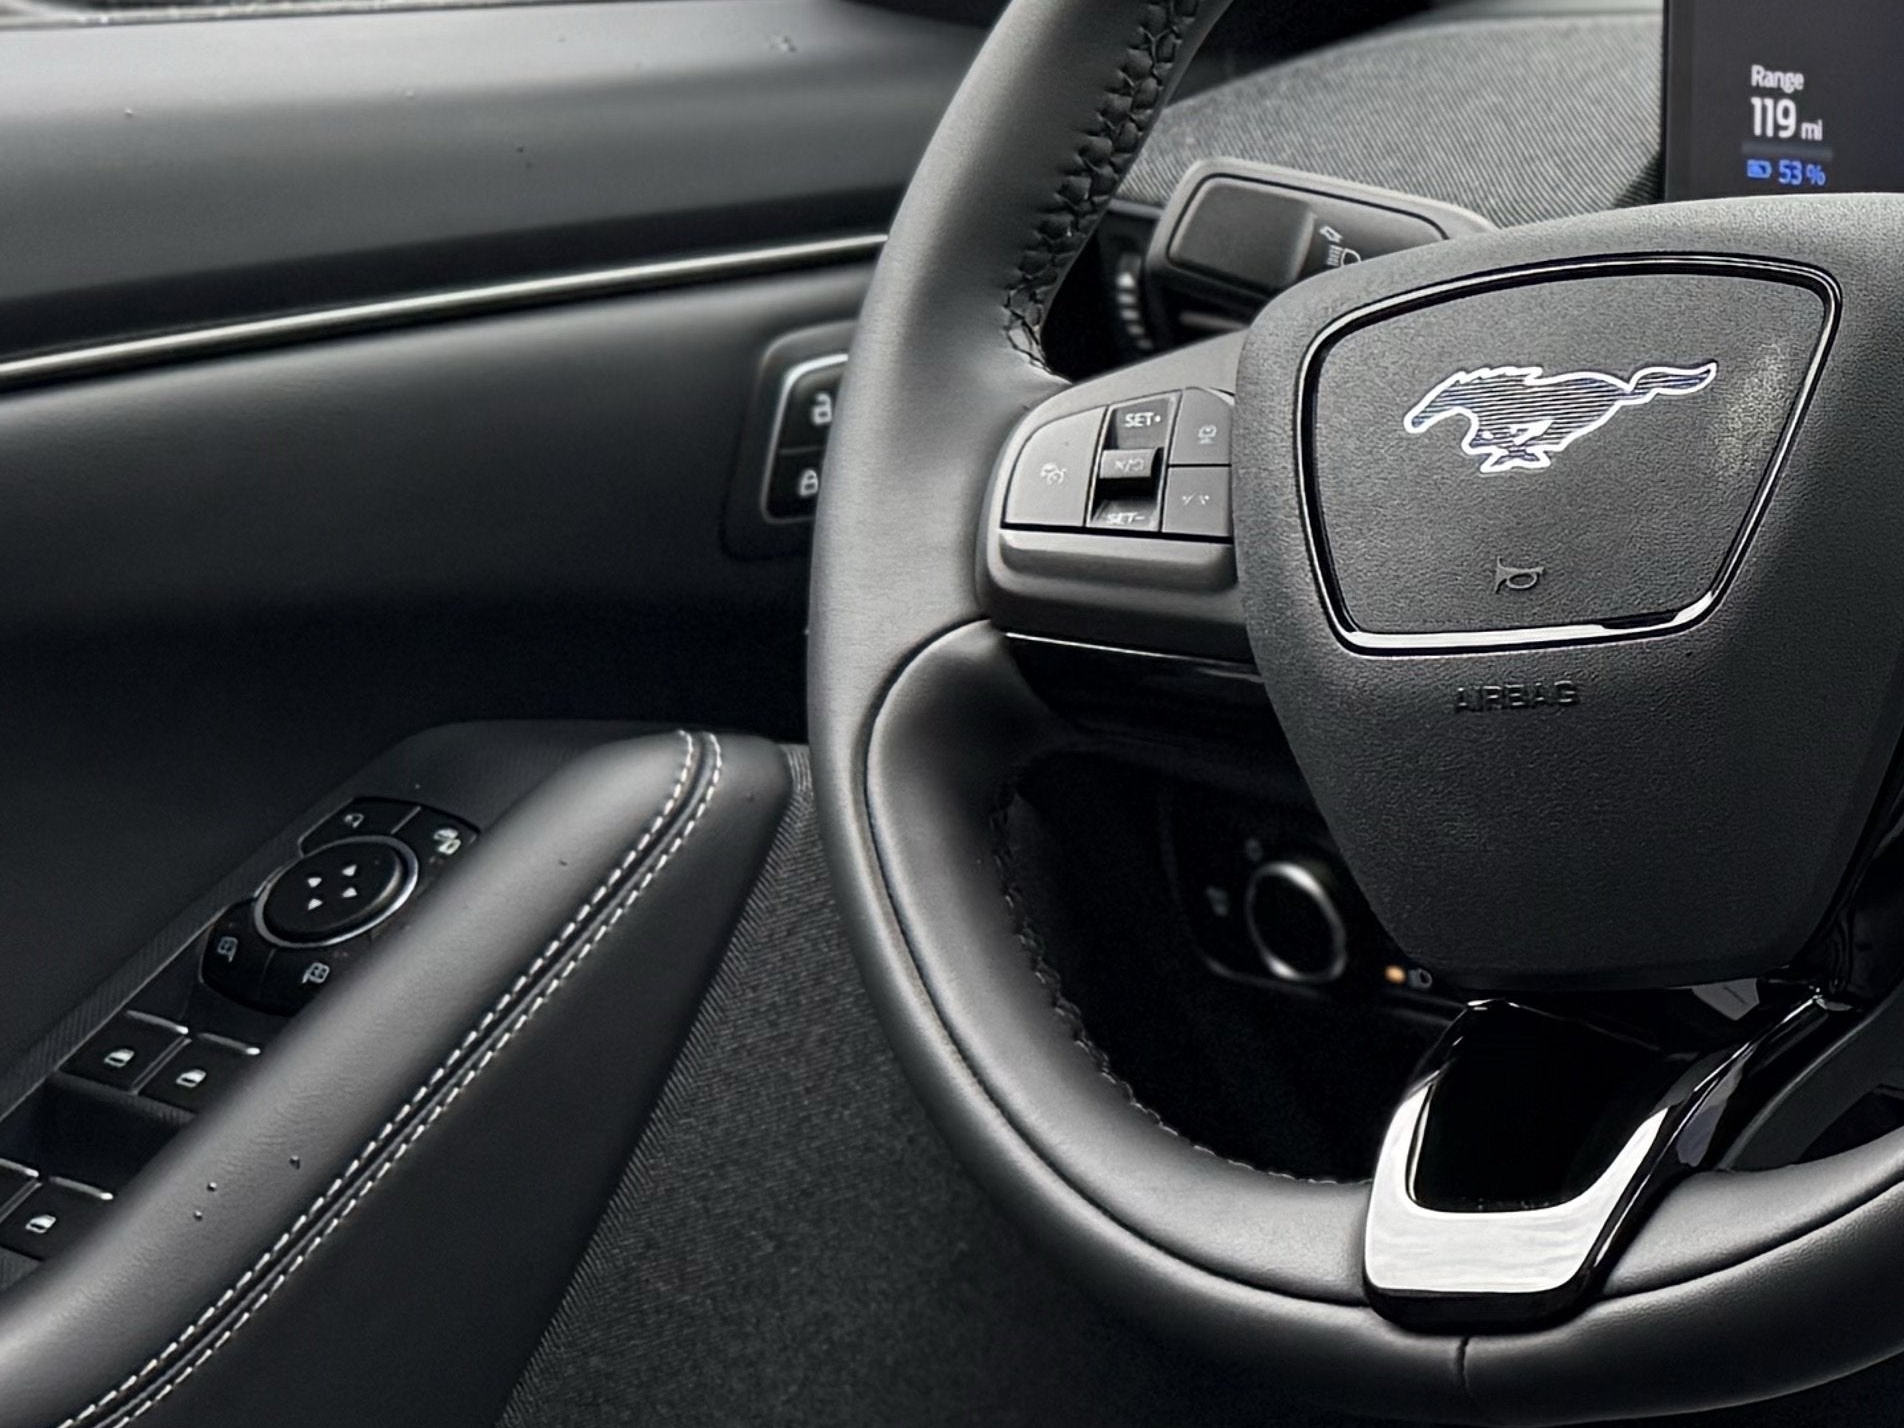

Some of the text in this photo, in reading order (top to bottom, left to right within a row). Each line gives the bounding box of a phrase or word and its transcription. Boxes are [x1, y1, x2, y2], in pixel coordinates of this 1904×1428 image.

[1751, 64, 1805, 94] Range
[1751, 96, 1824, 142] 119 mi
[1778, 159, 1803, 186] 53
[1455, 679, 1579, 713] AIRBAG
